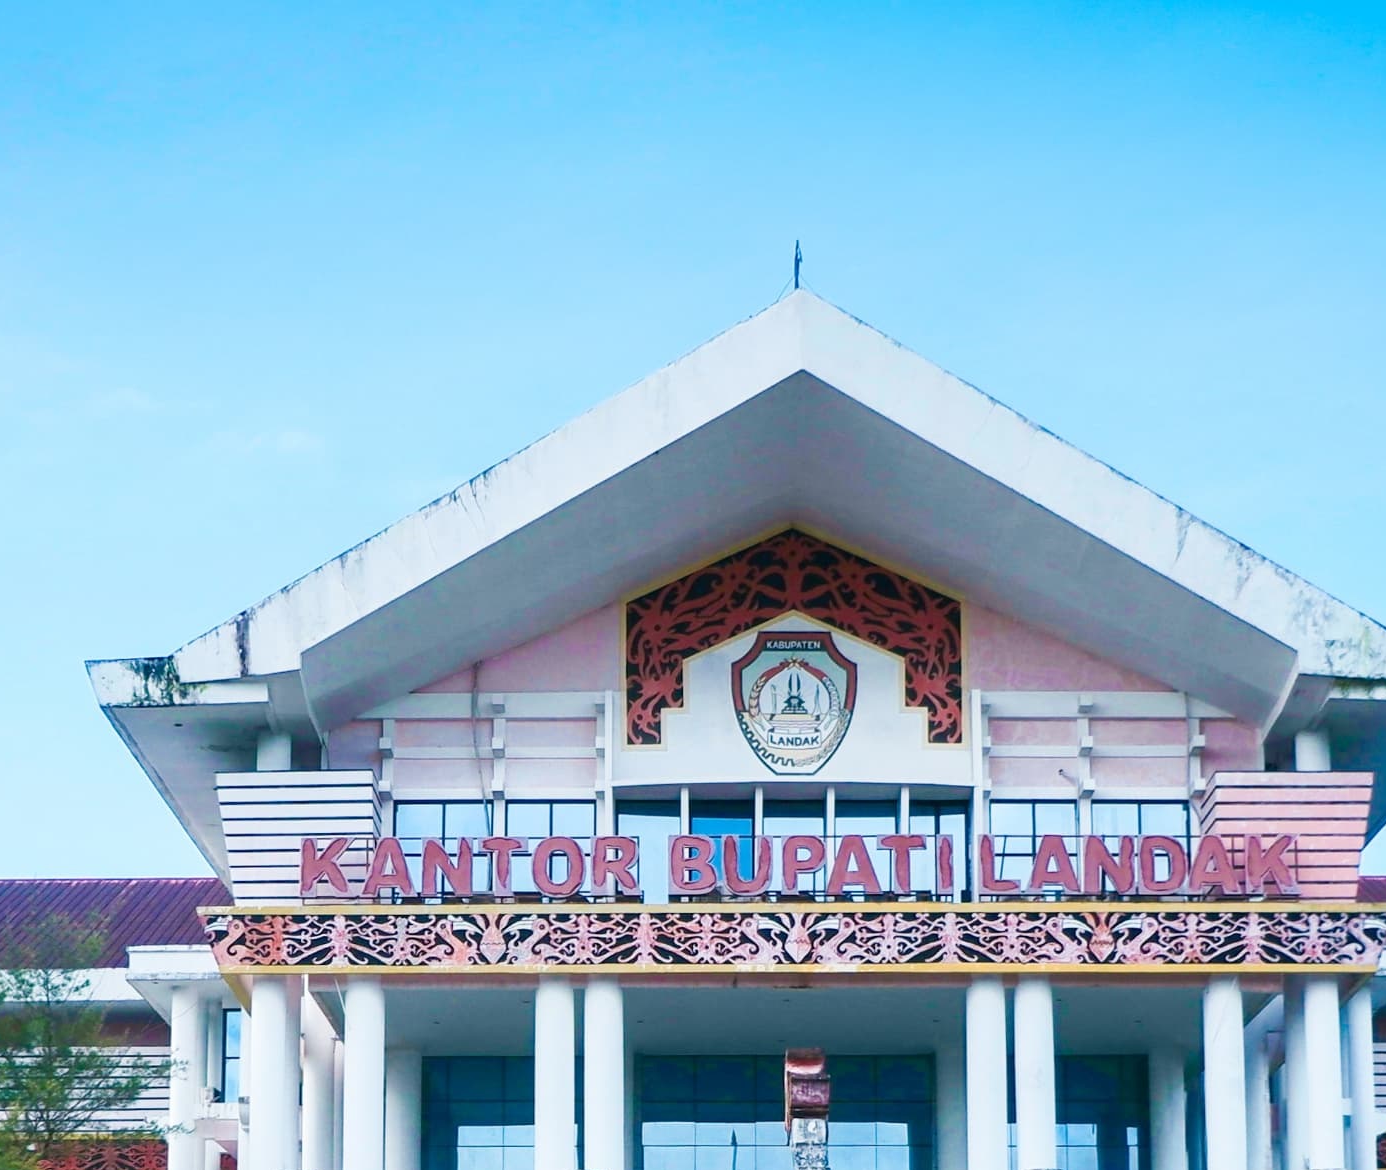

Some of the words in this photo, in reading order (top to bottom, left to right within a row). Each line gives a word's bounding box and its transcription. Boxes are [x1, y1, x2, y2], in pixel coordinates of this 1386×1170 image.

[766, 640, 821, 649] KABUPATEN
[770, 735, 819, 746] LANDAK
[300, 836, 643, 896] KANTOR
[669, 834, 954, 895] BUPATI
[978, 833, 1301, 895] LANDAK
